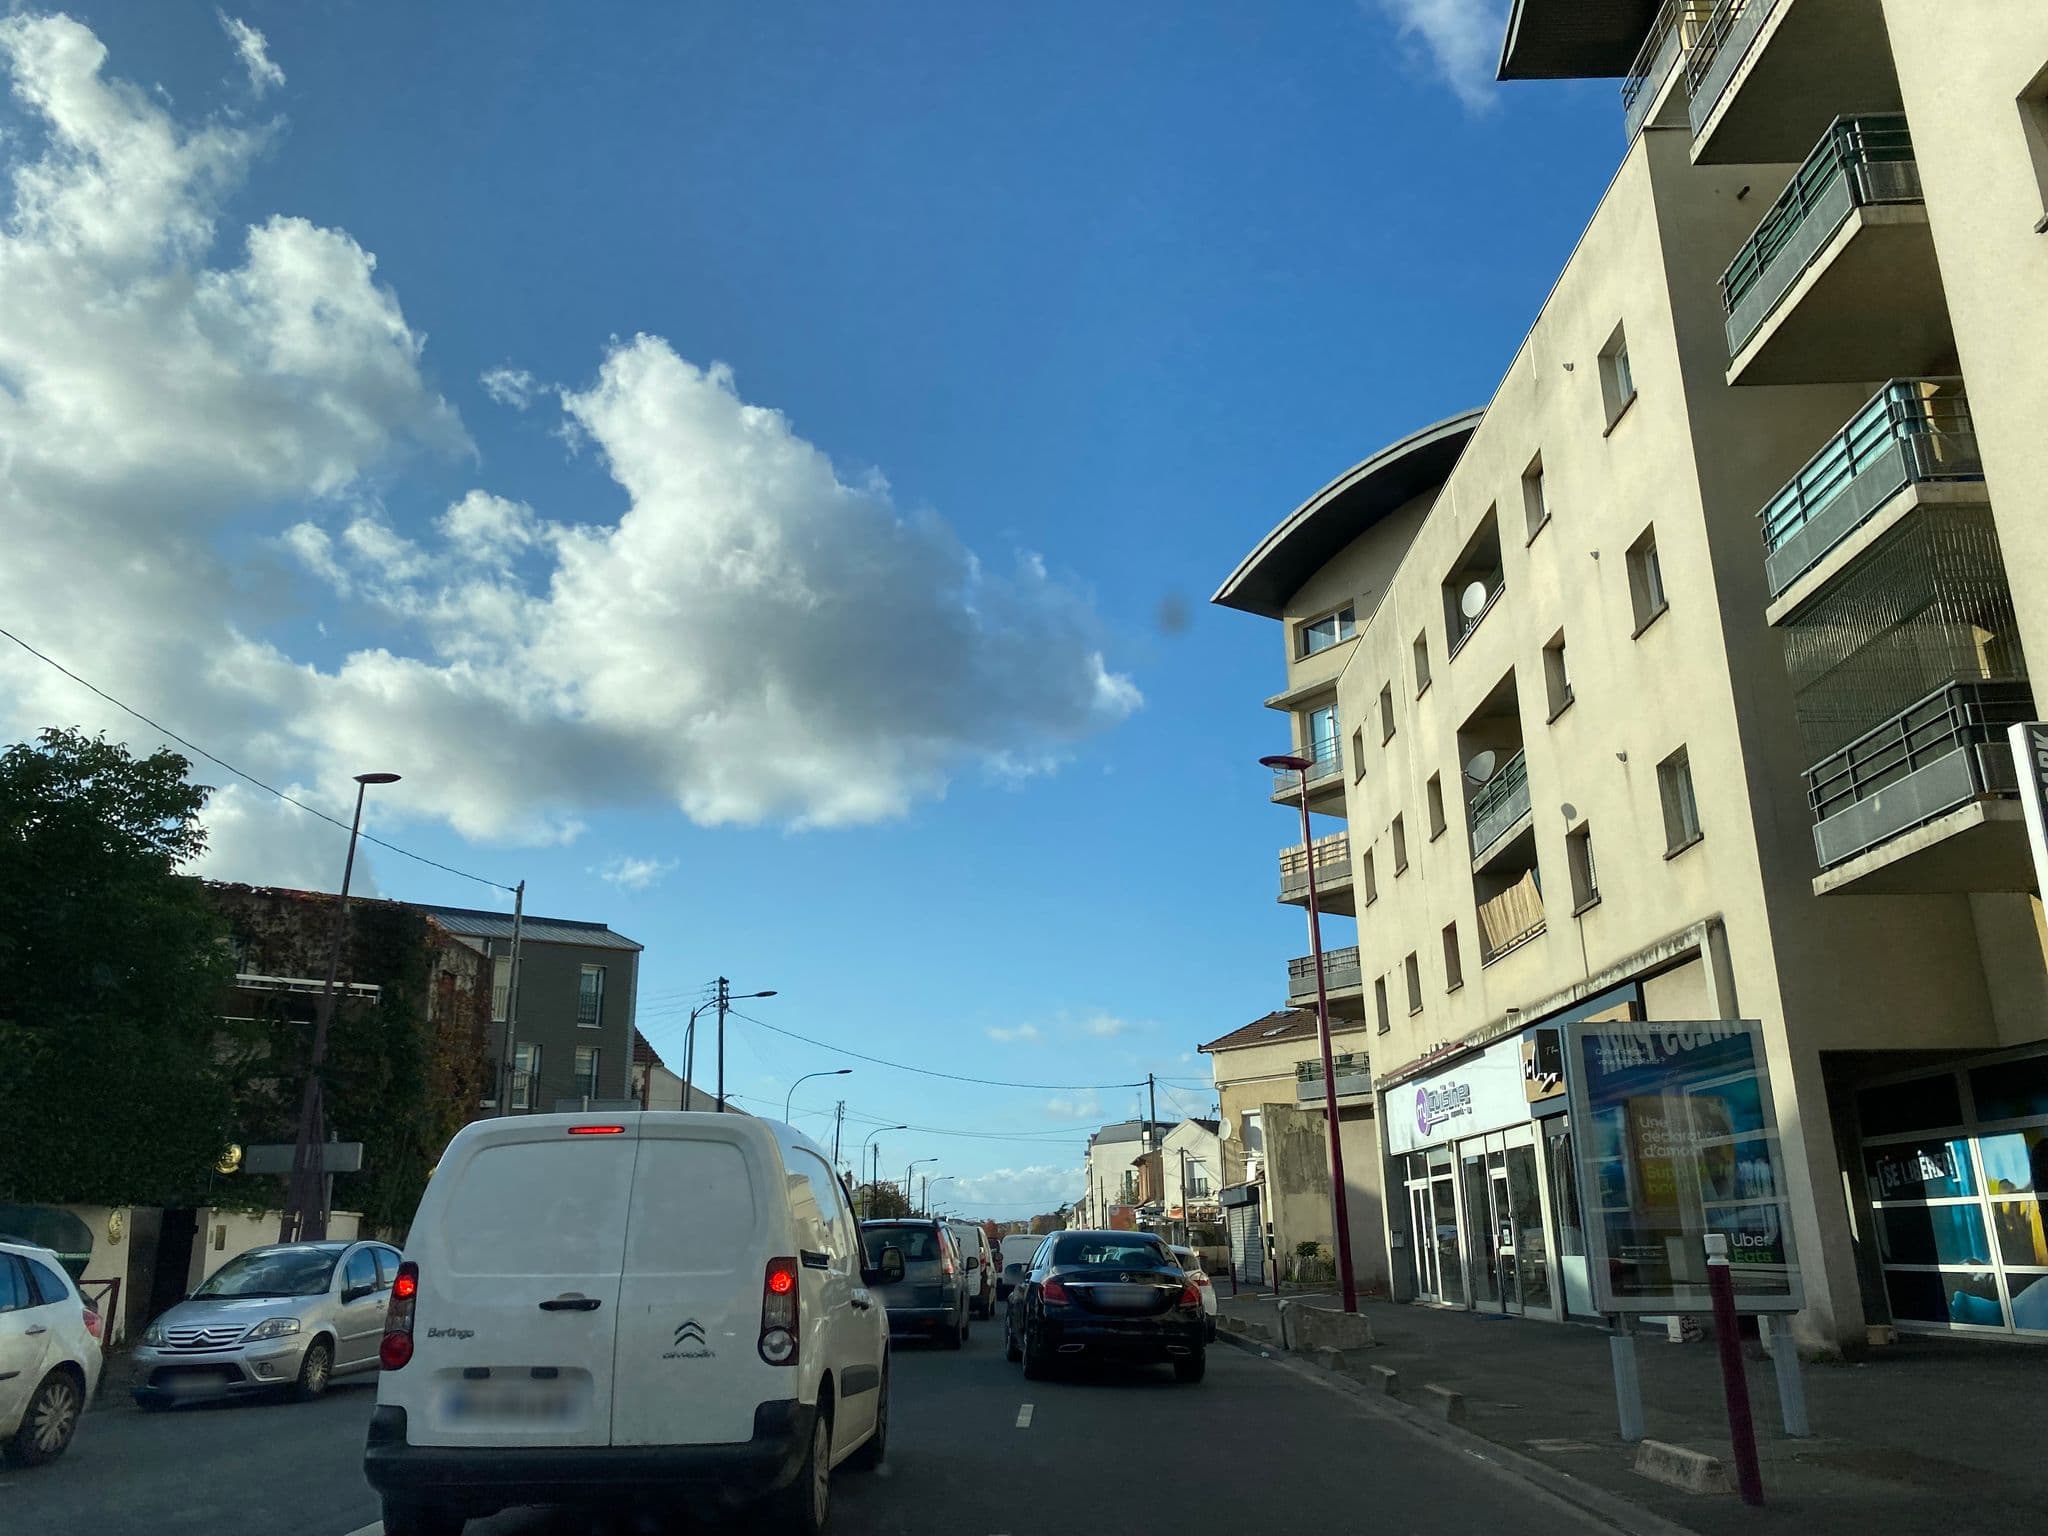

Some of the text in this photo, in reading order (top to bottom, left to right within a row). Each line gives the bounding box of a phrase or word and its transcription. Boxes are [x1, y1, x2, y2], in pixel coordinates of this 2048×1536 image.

[1730, 1232, 1769, 1247] Uber
[1733, 1248, 1773, 1263] Eats
[427, 1327, 475, 1340] Berlingo
